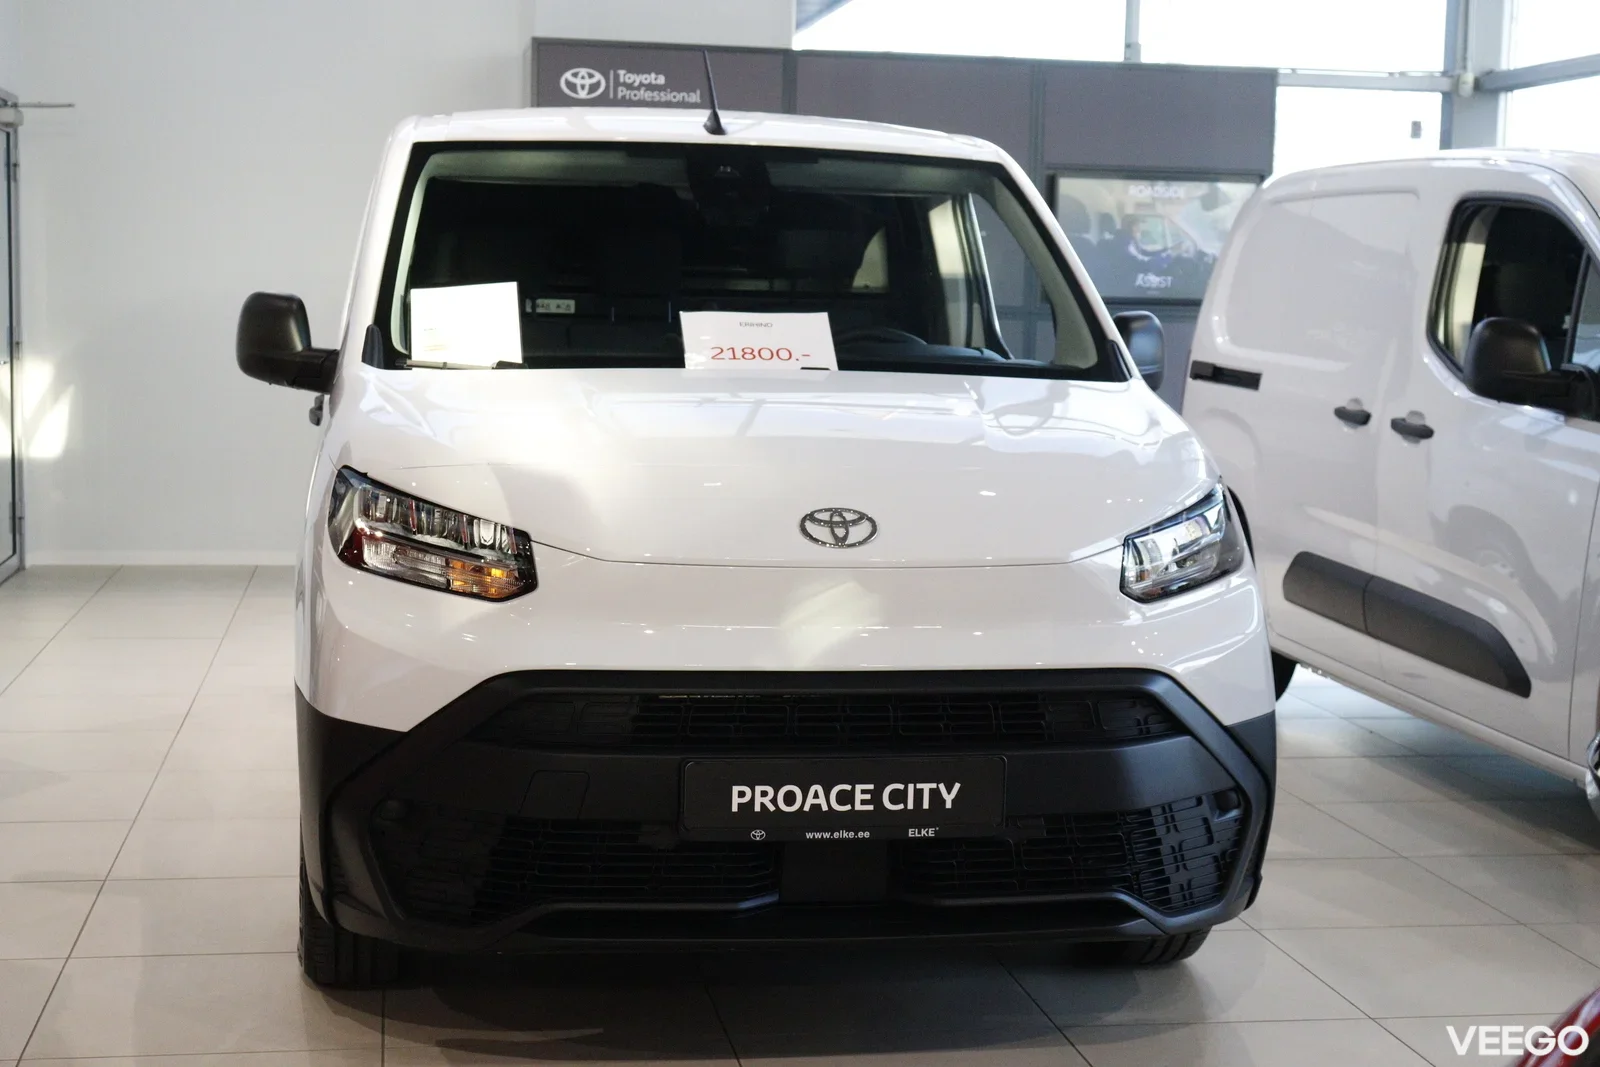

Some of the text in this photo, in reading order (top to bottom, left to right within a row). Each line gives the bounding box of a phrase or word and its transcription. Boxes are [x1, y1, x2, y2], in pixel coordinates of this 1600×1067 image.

[617, 69, 666, 87] Toyota
[617, 86, 701, 103] Professional
[710, 346, 811, 362] 21800.-
[731, 782, 962, 812] PROACE CITY
[805, 829, 871, 840] www.elke.ee
